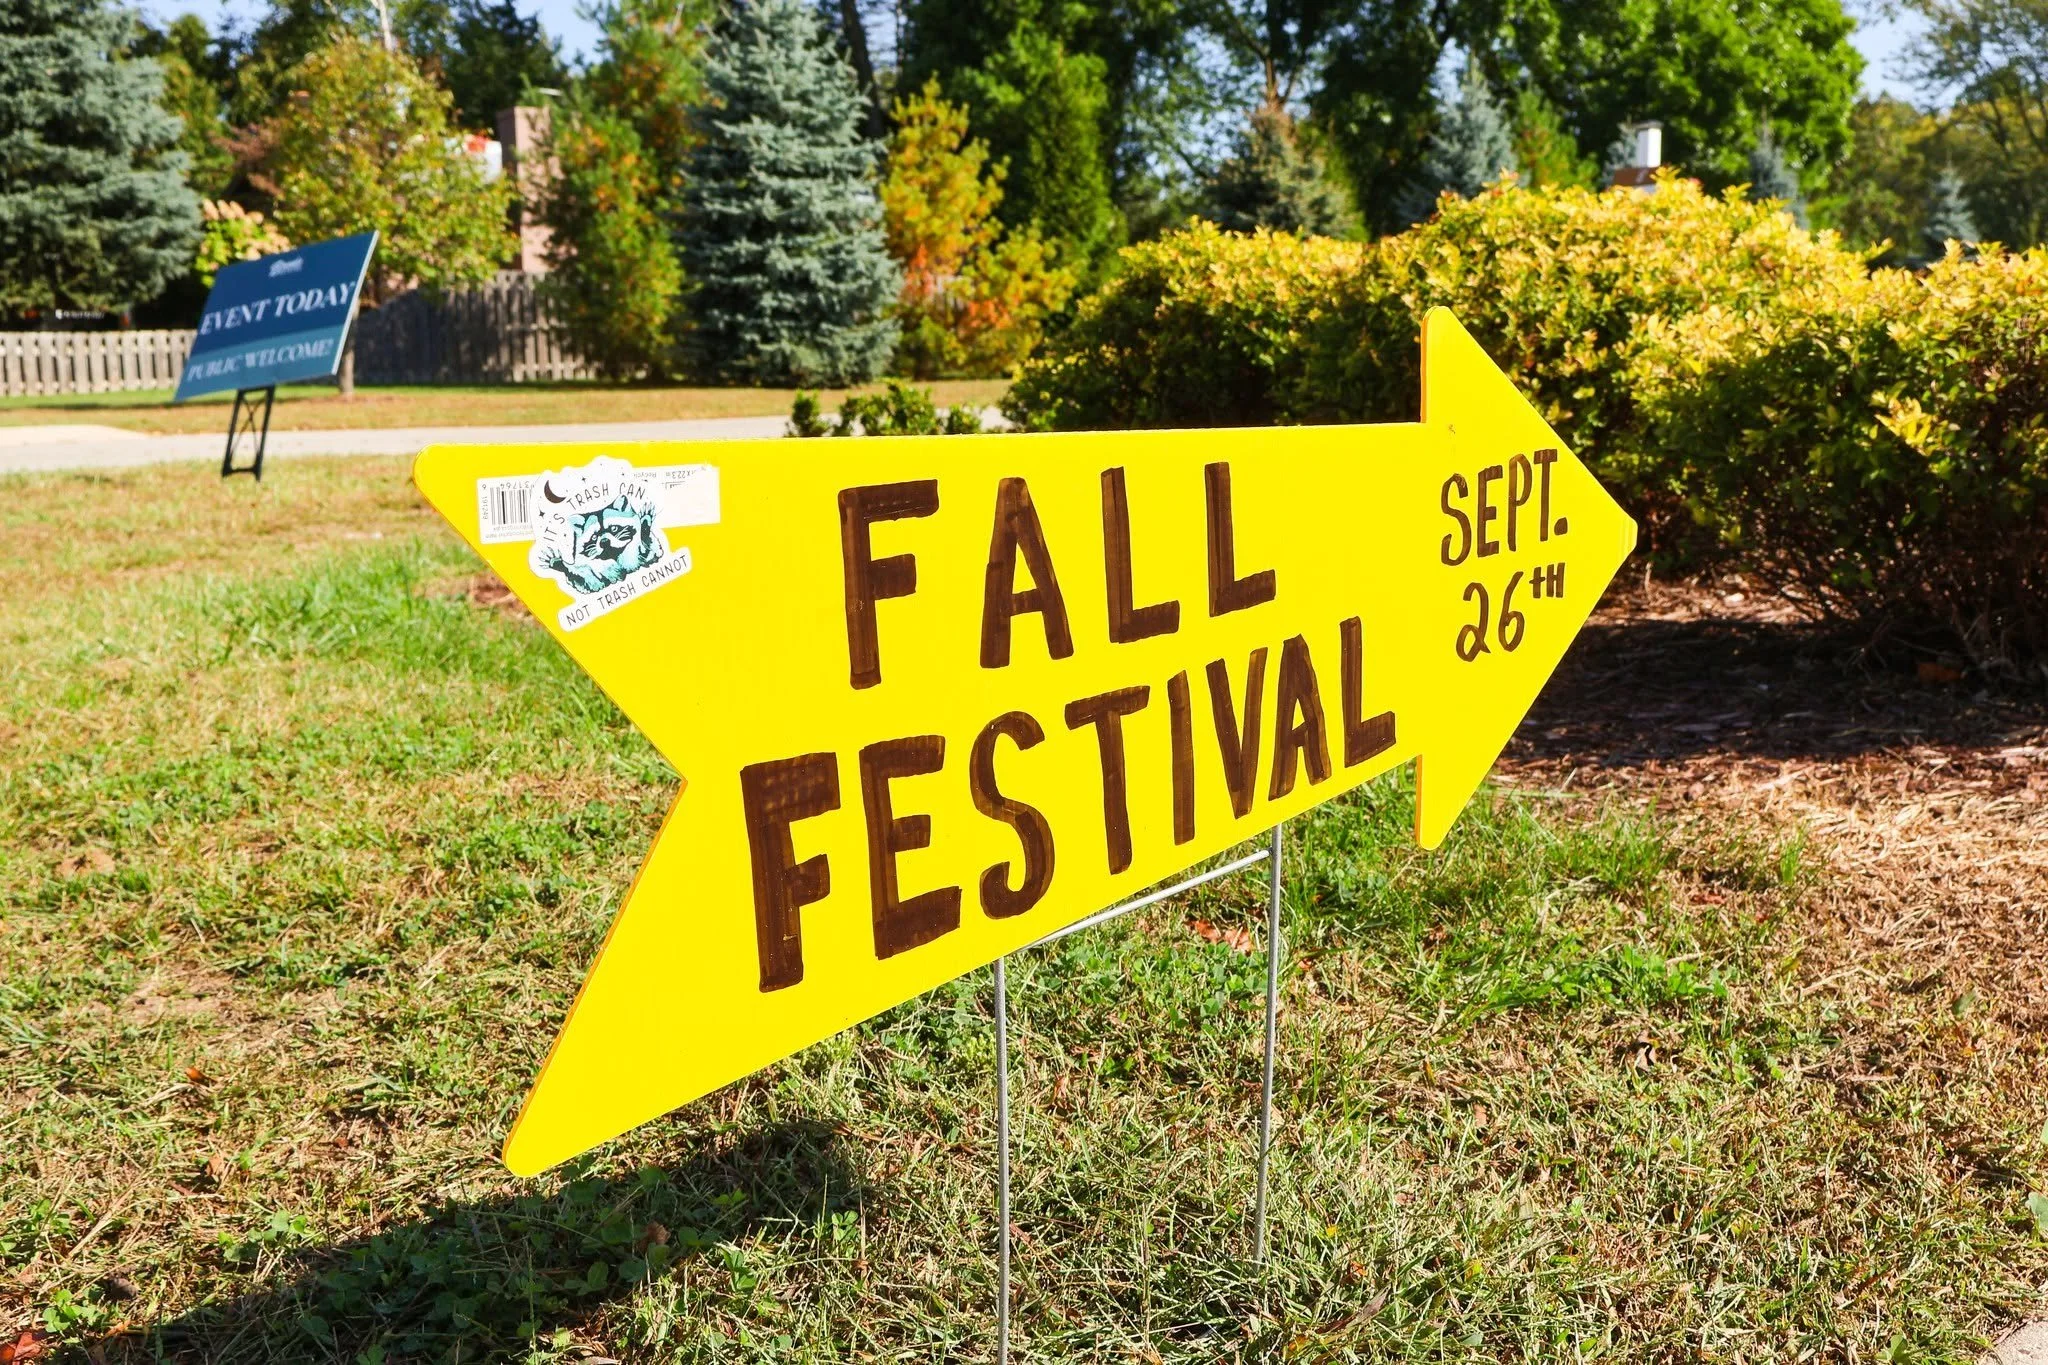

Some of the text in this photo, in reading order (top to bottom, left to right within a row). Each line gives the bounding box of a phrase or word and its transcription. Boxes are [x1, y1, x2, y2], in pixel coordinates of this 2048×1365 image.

[200, 281, 356, 335] EVENT TODAY
[187, 354, 243, 382] PUBLIC
[566, 482, 610, 511] TRASH
[1441, 448, 1568, 566] SEPT.
[566, 554, 688, 627] NOT TRASH CANNOT
[838, 461, 1277, 690] FALL
[740, 615, 1397, 993] FESTIVAL
